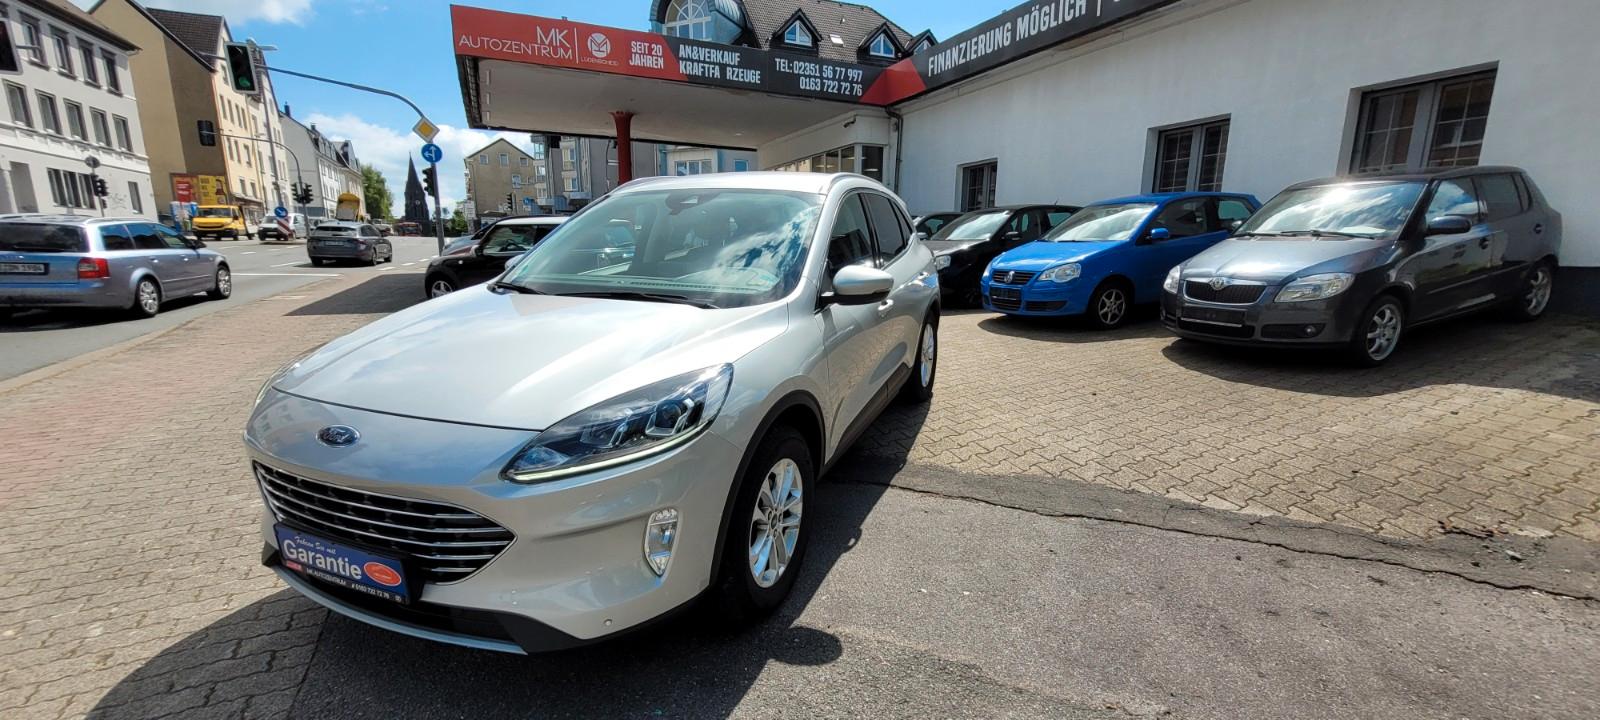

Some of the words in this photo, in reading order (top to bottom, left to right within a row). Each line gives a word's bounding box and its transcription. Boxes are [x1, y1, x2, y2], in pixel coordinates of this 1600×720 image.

[536, 25, 570, 47] MK
[928, 22, 1012, 77] FINANZIERUNG
[1016, 0, 1086, 41] MÖGLICH
[459, 35, 572, 60] AUTOZENTRUM
[631, 41, 650, 54] SEIT
[651, 43, 662, 56] 20
[679, 44, 740, 66] AN&VERKAUF
[629, 54, 664, 69] JAHREN
[679, 61, 720, 79] KRAFTFA
[726, 67, 761, 84] RZEUGE
[822, 65, 833, 79] 56
[835, 67, 846, 80] 77
[847, 68, 863, 82] 997
[800, 76, 821, 91] 0163
[823, 80, 839, 94] 722
[840, 82, 851, 95] 72
[852, 83, 863, 97] 76
[283, 539, 362, 580] Garantie
